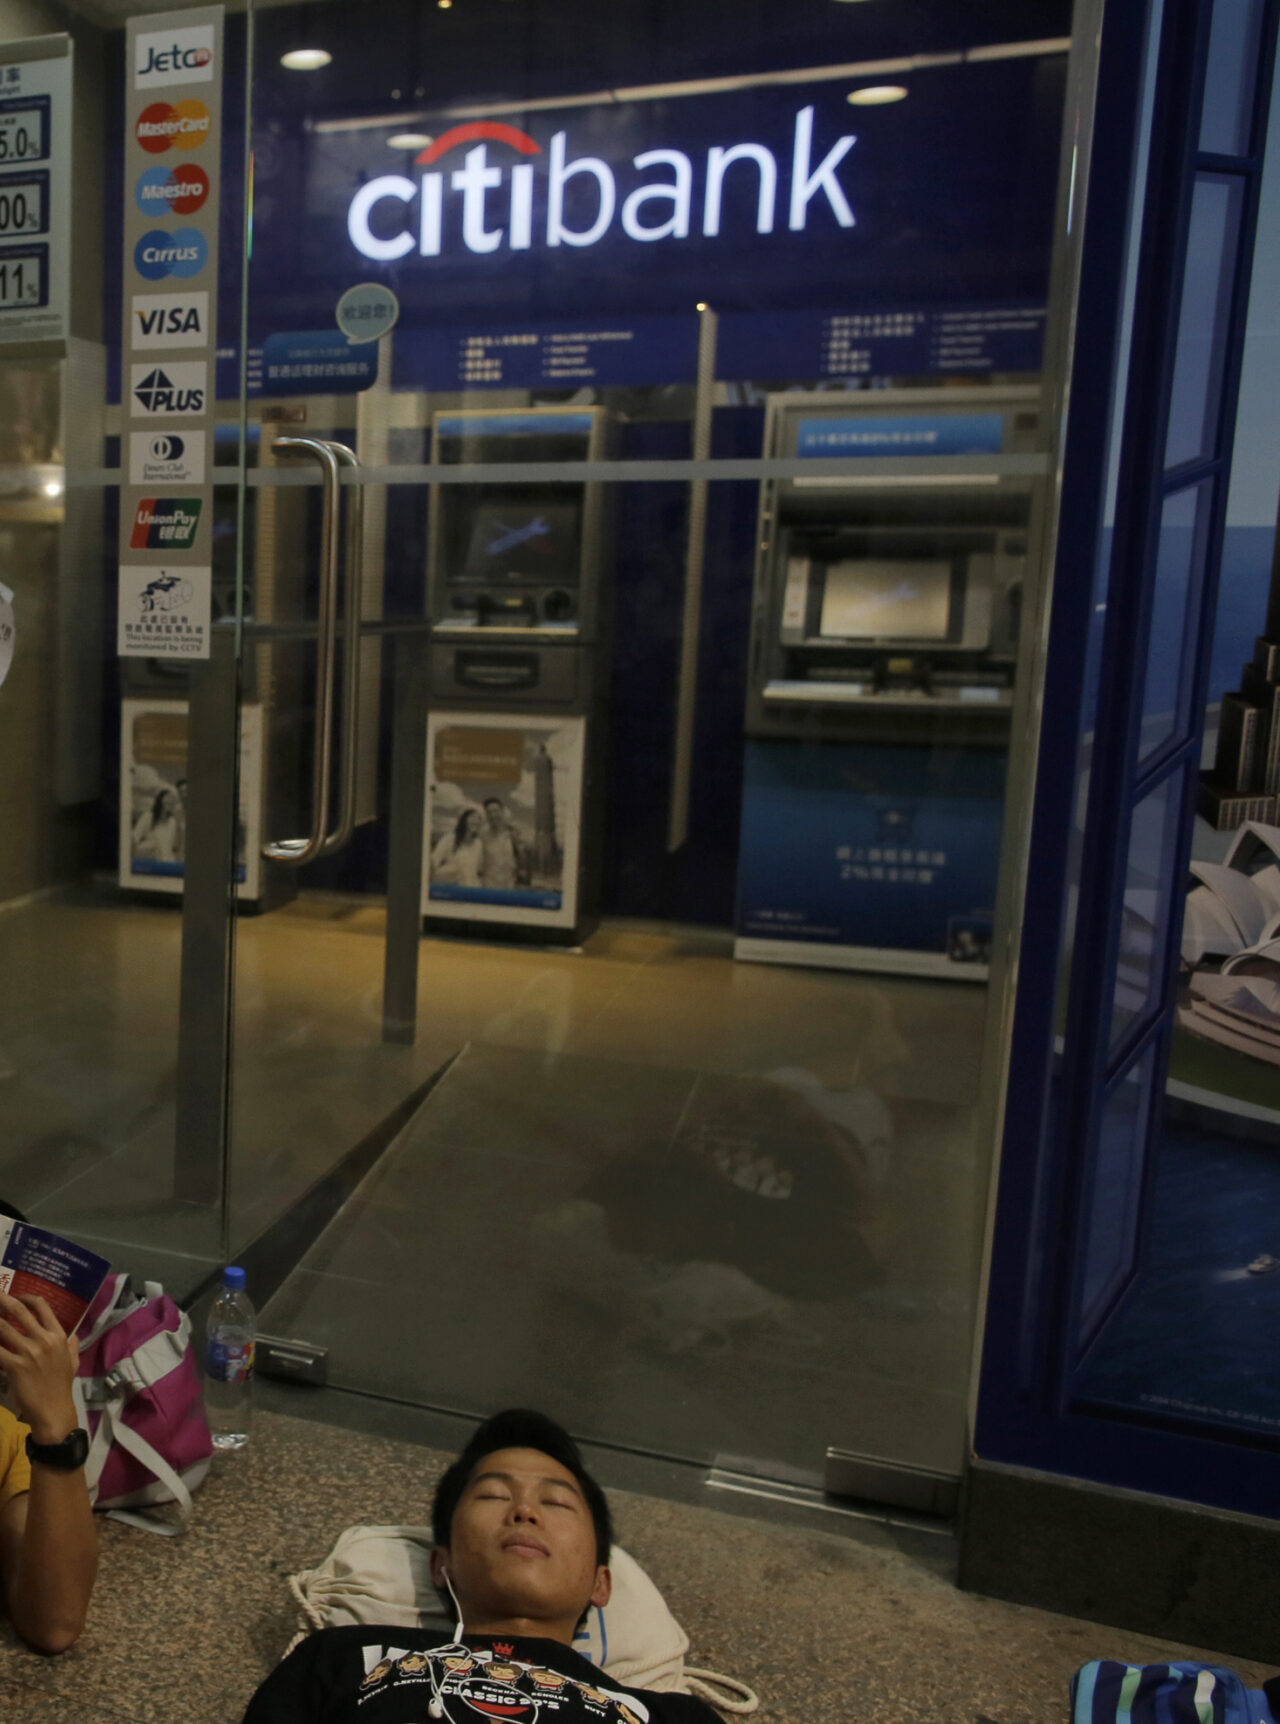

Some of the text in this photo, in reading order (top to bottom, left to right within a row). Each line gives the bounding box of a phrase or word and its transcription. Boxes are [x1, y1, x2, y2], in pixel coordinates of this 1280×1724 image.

[137, 116, 210, 138] MasterCard
[141, 181, 204, 202] Maestro
[348, 104, 858, 261] citibank
[142, 246, 199, 264] Cirrus
[134, 308, 201, 335] VISA
[152, 389, 204, 412] PLUS
[137, 509, 197, 530] UnionPay
[441, 1685, 517, 1706] CLASSIC
